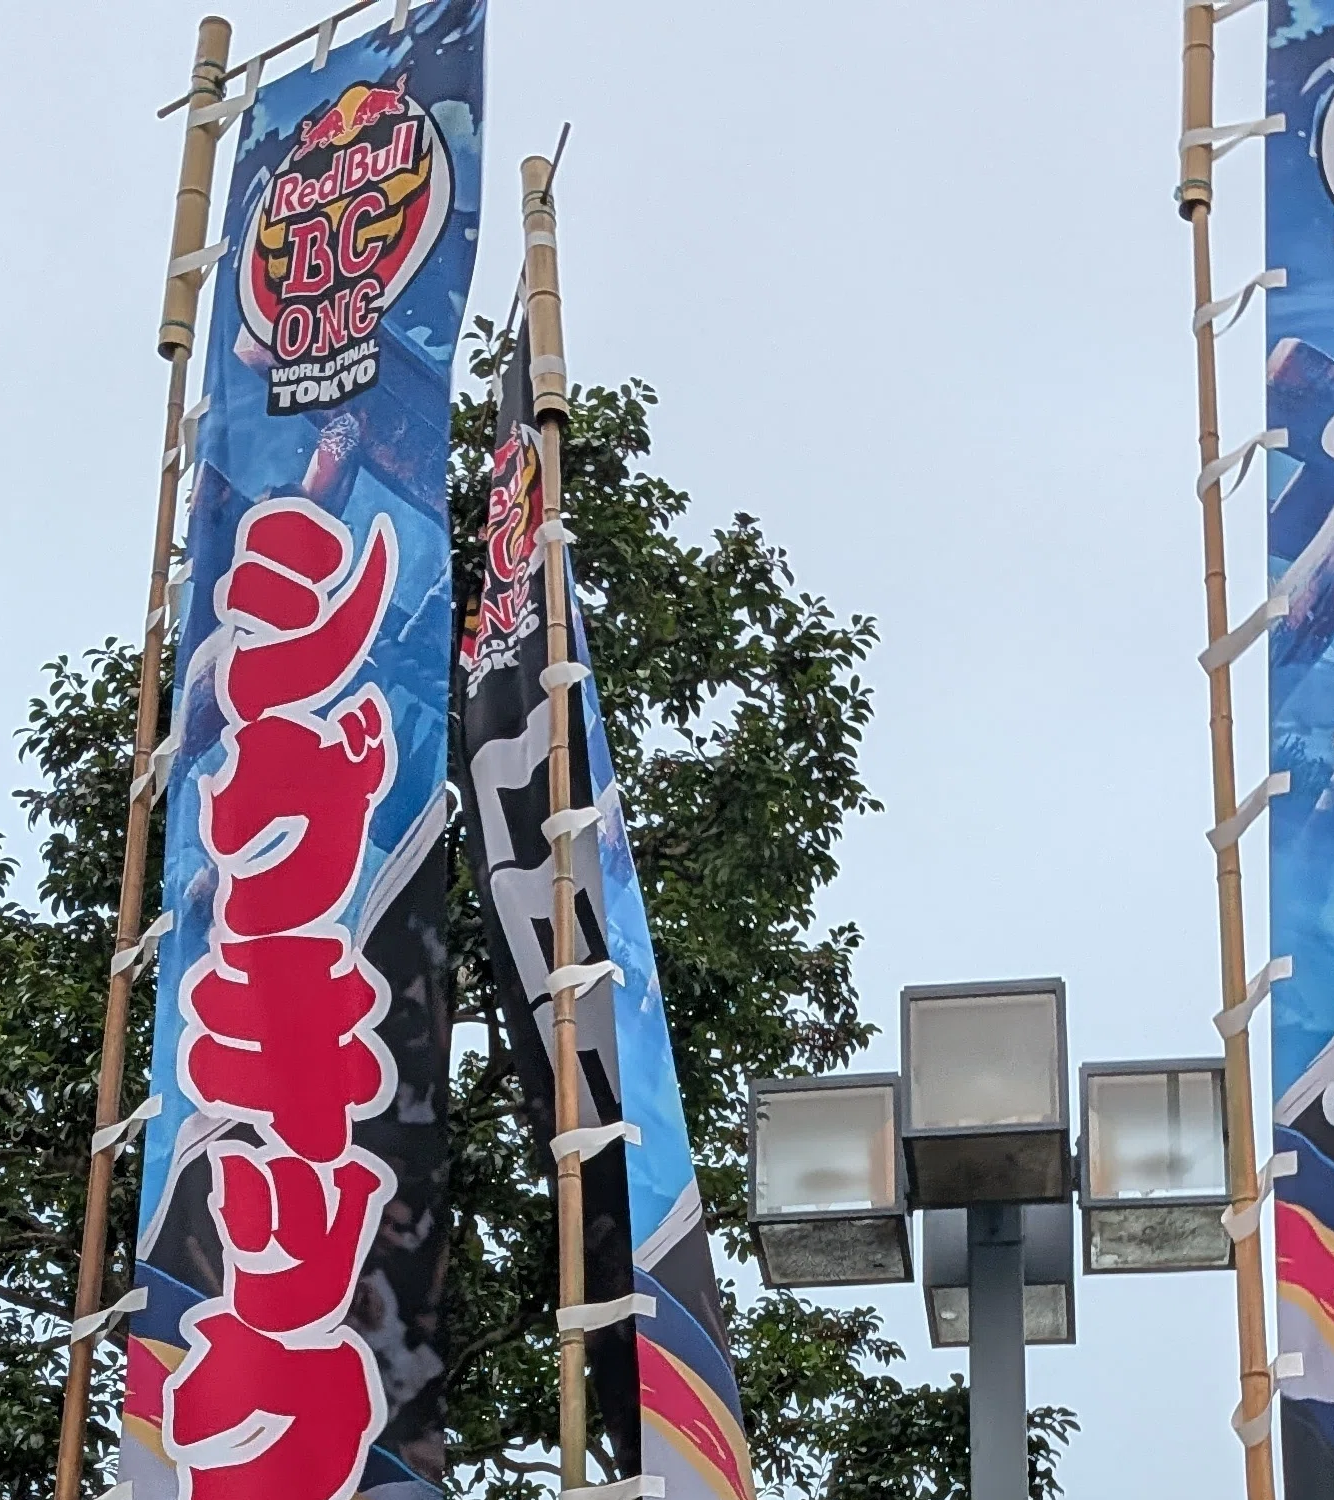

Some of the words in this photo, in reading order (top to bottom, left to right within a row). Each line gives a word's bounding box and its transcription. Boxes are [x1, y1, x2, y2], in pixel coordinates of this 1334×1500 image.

[270, 150, 345, 223] Red
[342, 121, 418, 195] Bull
[282, 192, 387, 299] BC
[271, 361, 336, 383] WORLD
[335, 339, 380, 371] FINAL
[277, 278, 381, 361] ONE
[272, 358, 377, 408] TOKYO
